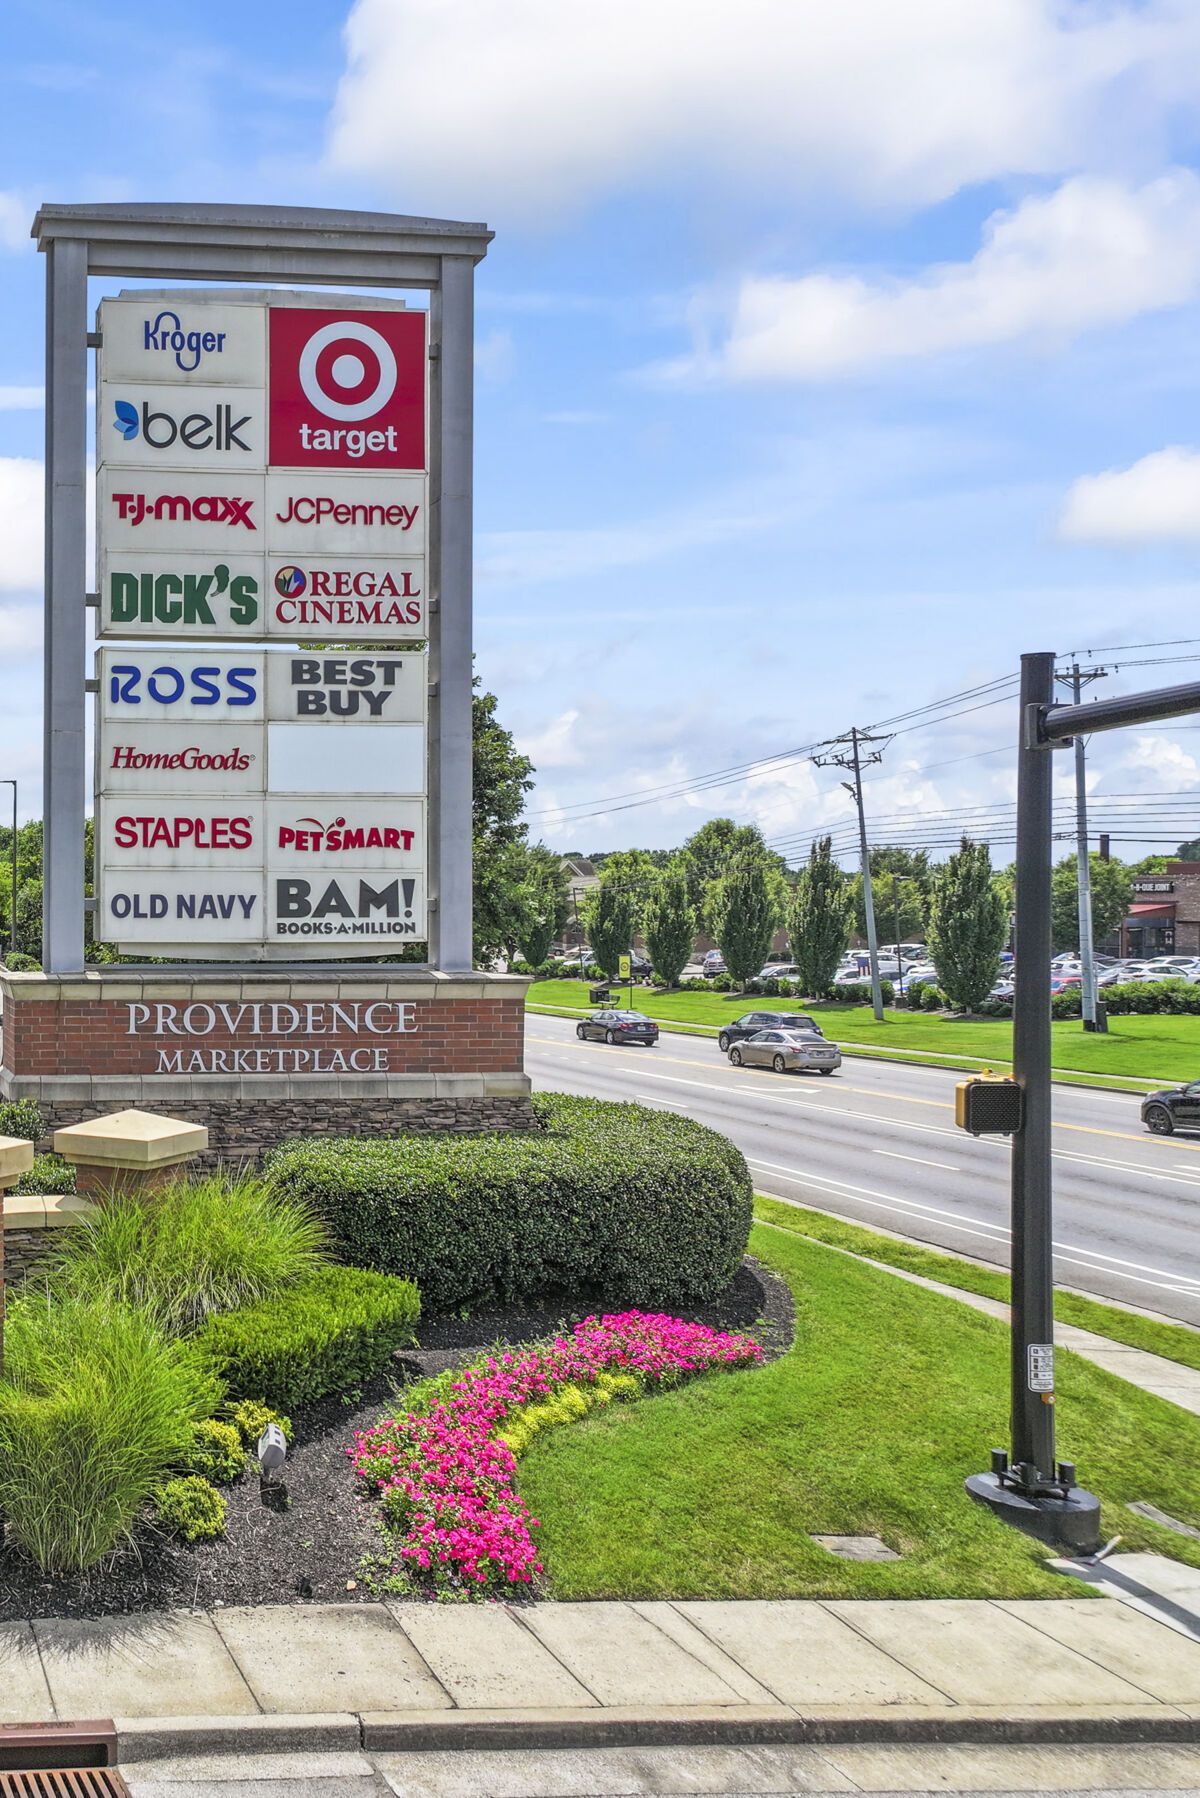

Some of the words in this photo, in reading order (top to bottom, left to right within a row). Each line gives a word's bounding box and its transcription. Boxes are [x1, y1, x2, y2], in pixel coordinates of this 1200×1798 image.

[144, 311, 226, 371] Kroger
[142, 401, 252, 451] belk
[299, 423, 397, 457] target
[276, 496, 419, 531] JCPenney
[111, 564, 258, 625] DICK'S
[309, 571, 421, 597] REGAL
[275, 600, 421, 624] CINEMAS
[111, 665, 257, 706] ROSS
[291, 659, 403, 685] BEST
[297, 690, 392, 716] BUY
[114, 816, 253, 849] STAPLES
[111, 893, 168, 919] OLD
[177, 894, 257, 919] NAVY
[276, 878, 416, 918] BAM!
[125, 1003, 418, 1035] PROVIDENCE
[155, 1048, 389, 1073] MARKETPLACE
